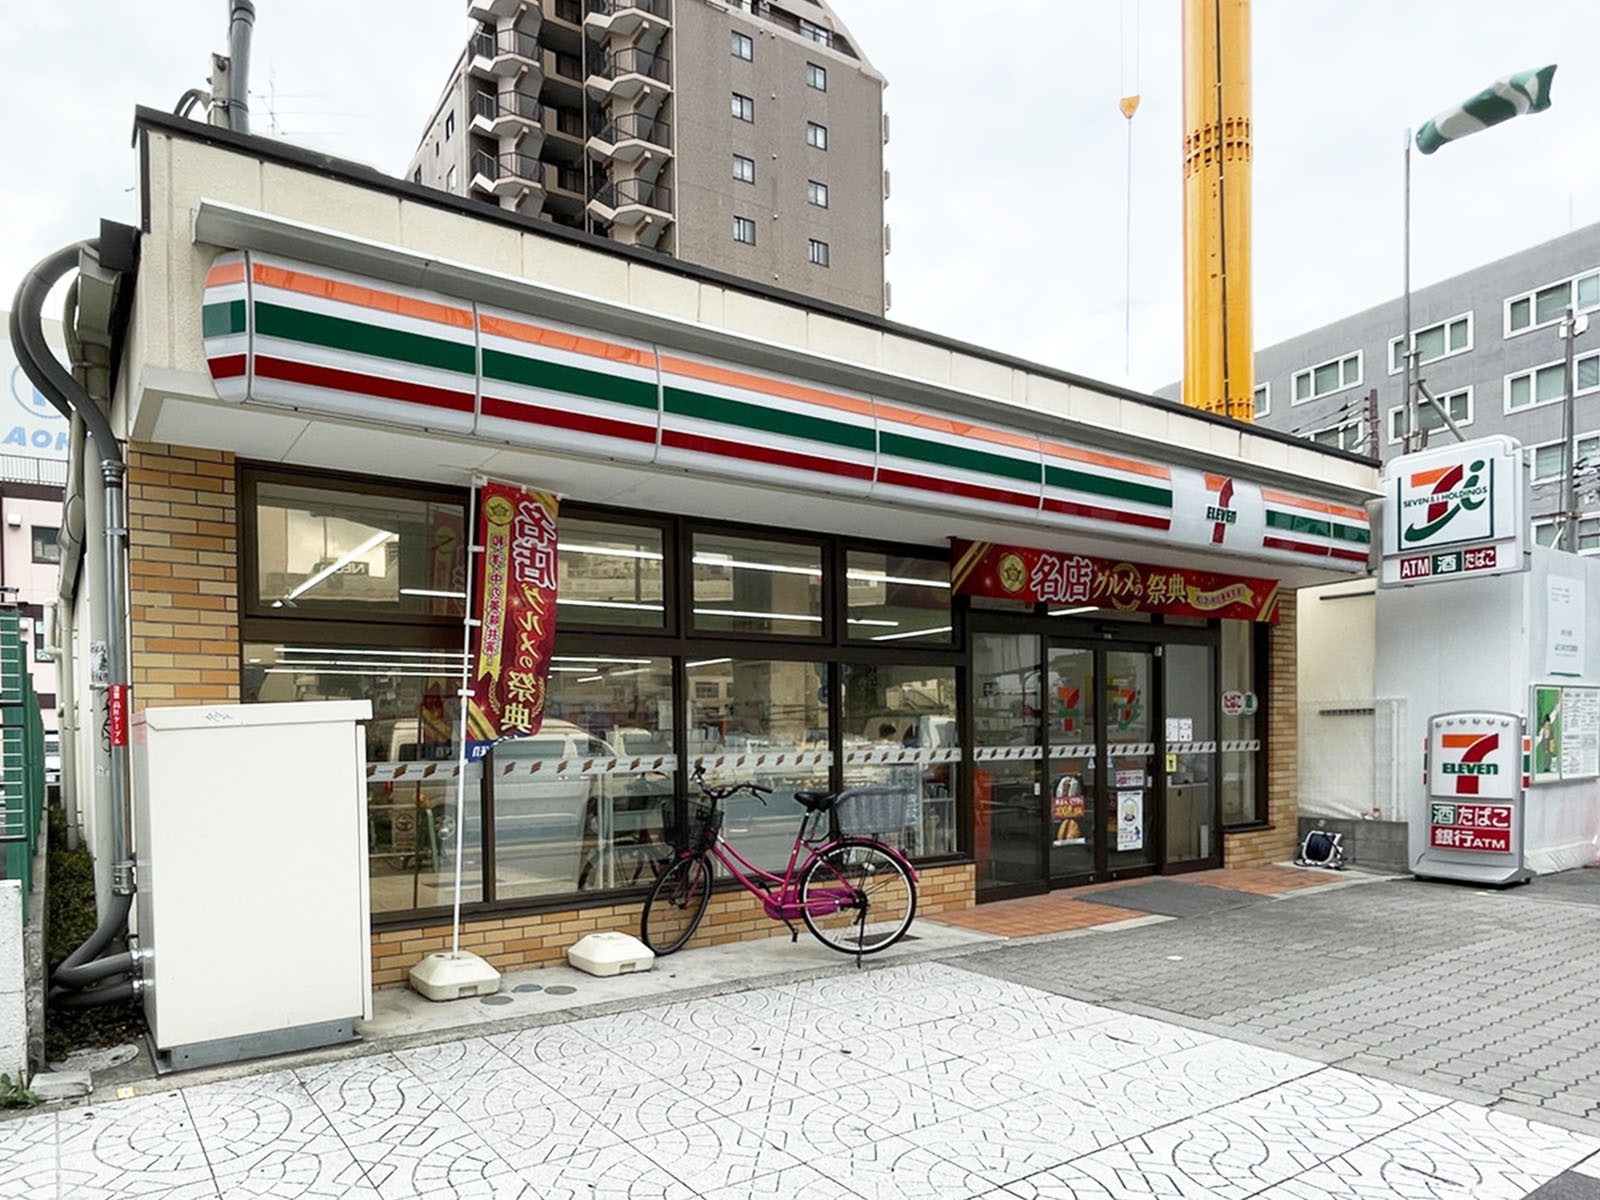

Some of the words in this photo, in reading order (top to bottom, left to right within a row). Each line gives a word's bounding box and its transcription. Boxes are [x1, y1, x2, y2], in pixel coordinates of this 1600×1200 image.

[1403, 497, 1429, 508] SEVEN
[1441, 486, 1488, 500] HOLDINGS
[1402, 558, 1429, 577] ATM
[1437, 554, 1457, 573] 酒
[1465, 549, 1496, 568] たばこ
[1433, 805, 1455, 825] 酒
[1458, 806, 1509, 828] たばこ
